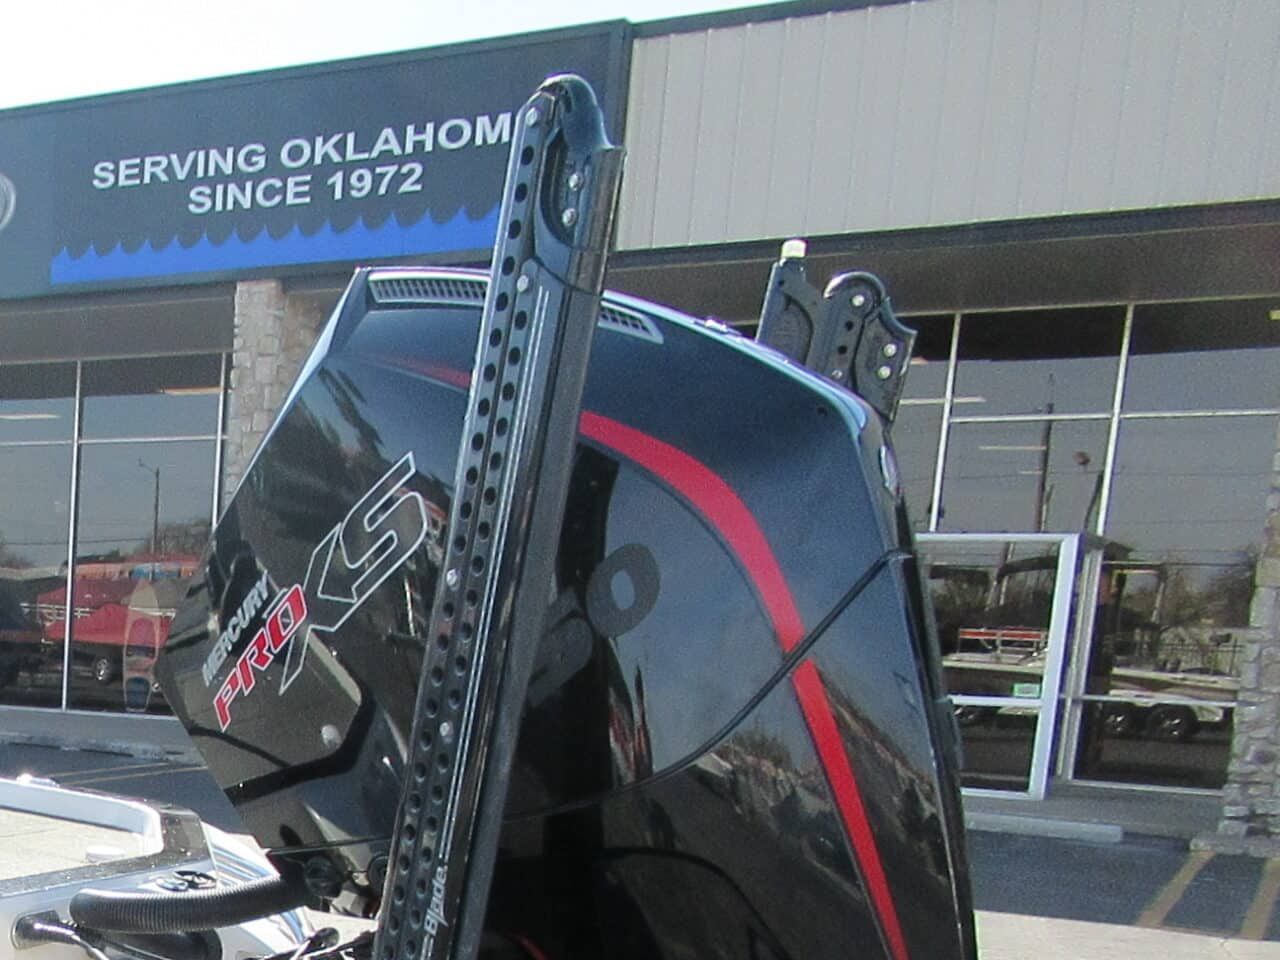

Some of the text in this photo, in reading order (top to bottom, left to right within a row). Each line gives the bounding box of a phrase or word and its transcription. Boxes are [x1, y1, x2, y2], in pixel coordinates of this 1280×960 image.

[92, 112, 512, 189] SERVING OKLAHOM
[187, 162, 425, 215] SINCE 1972
[201, 569, 271, 688] MERCURY
[213, 450, 429, 733] PRO XS
